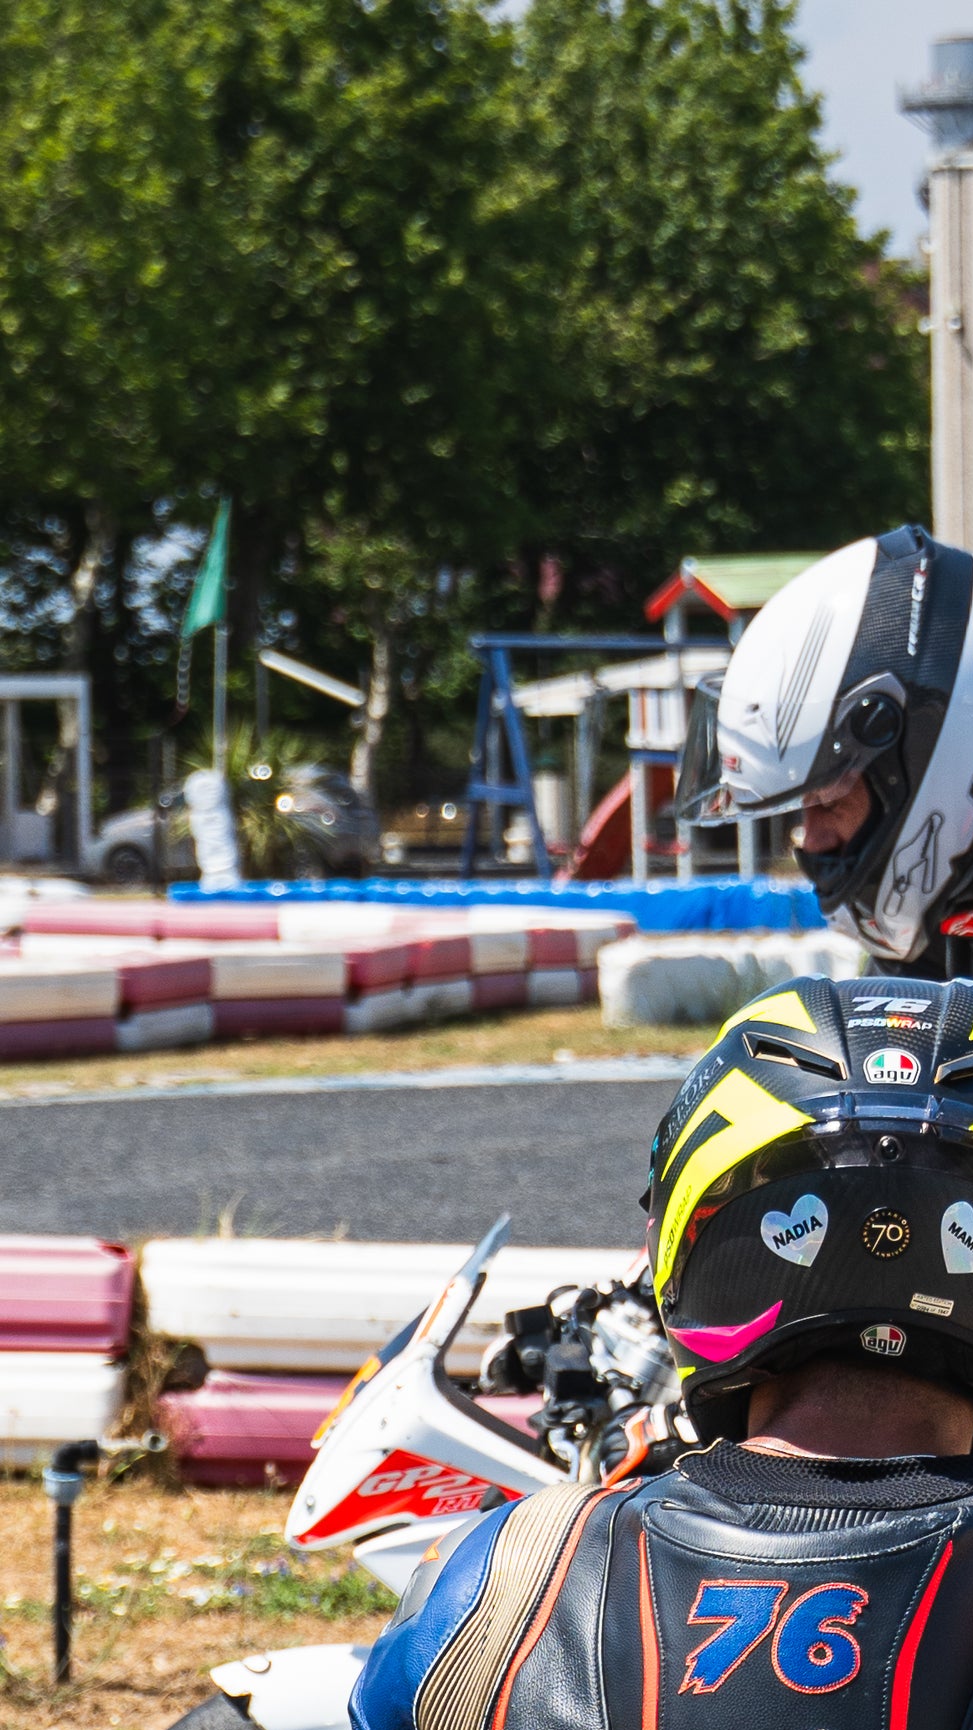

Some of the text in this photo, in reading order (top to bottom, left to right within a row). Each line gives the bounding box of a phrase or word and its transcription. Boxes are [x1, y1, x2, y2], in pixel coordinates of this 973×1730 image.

[852, 996, 932, 1014] 76
[874, 1069, 911, 1082] agv
[772, 1215, 823, 1250] NADIA
[871, 1223, 903, 1252] 70
[867, 1338, 900, 1354] agv
[677, 1579, 870, 1695] 76
